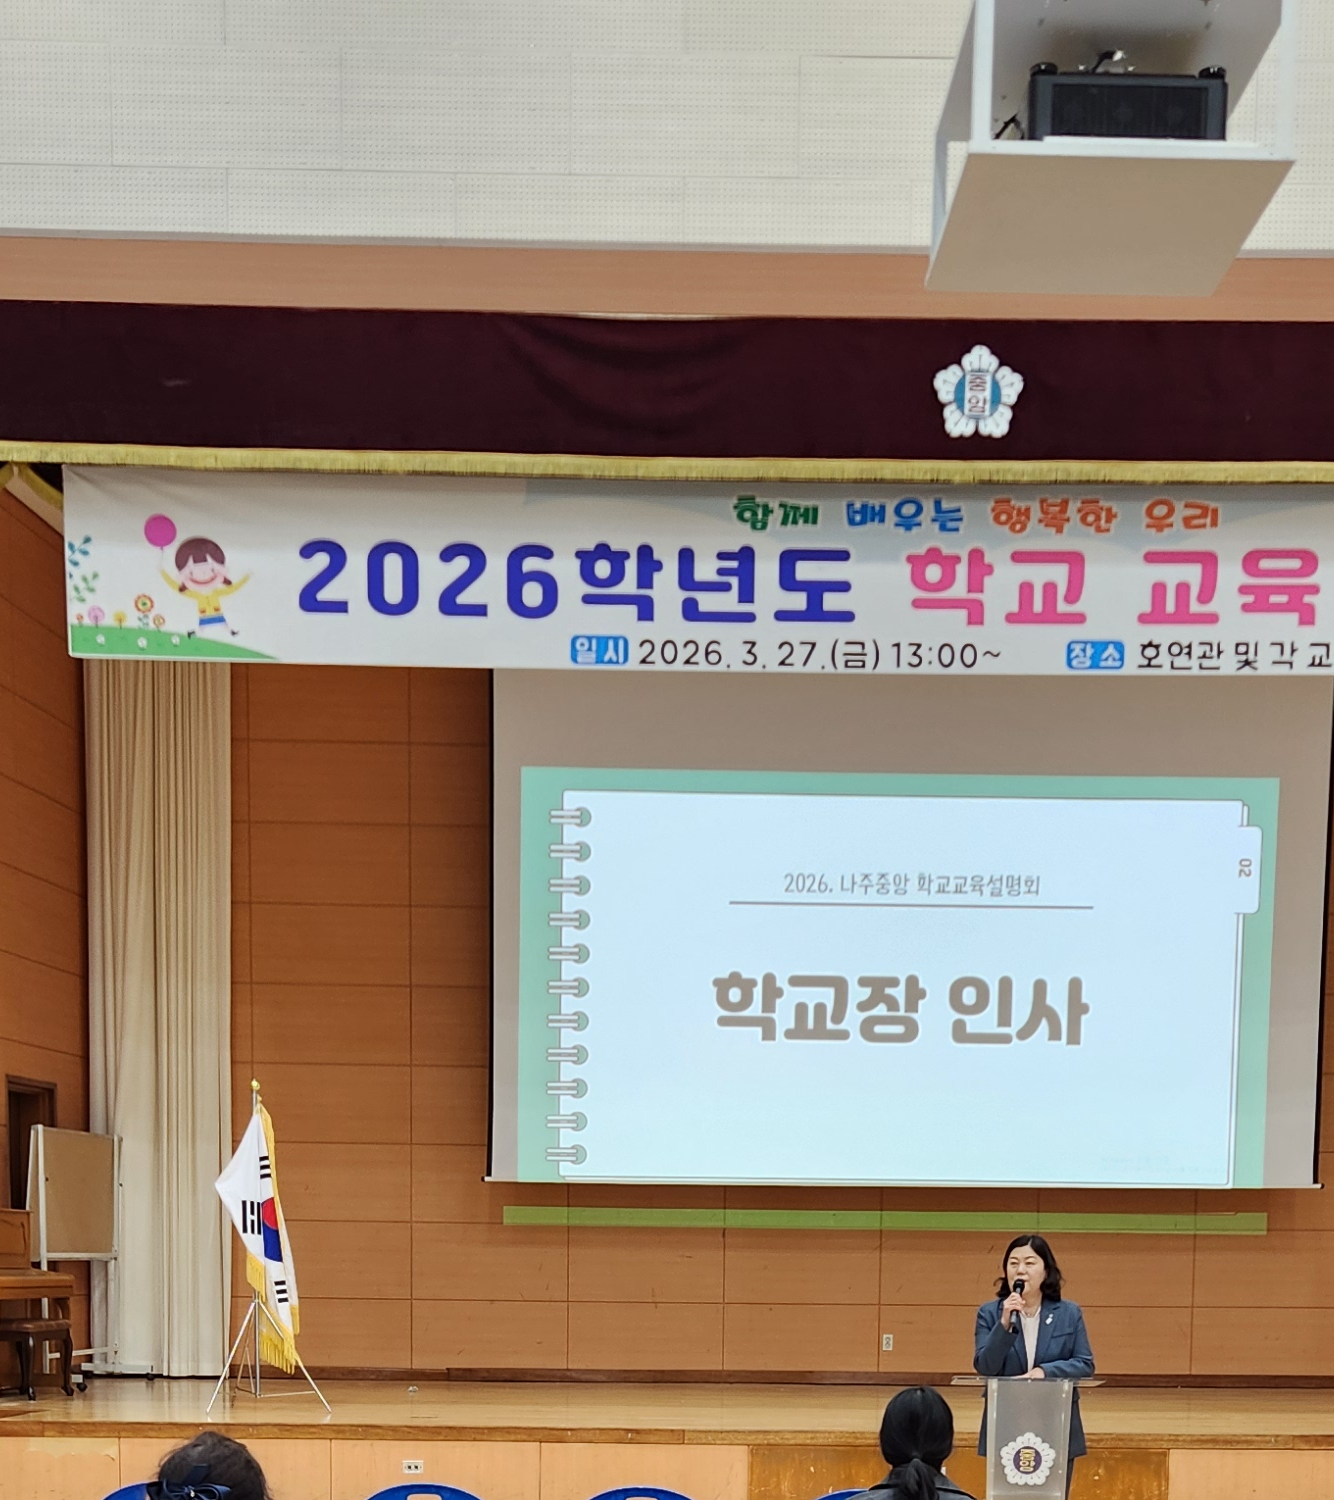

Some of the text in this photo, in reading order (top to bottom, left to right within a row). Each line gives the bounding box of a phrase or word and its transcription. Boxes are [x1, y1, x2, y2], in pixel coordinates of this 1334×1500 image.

[732, 494, 1220, 535] 함께 배우는 행복한 우리
[296, 538, 857, 624] 2026학년도
[905, 546, 1088, 627] 학교
[1136, 547, 1321, 628] 교육
[574, 638, 626, 663] 일시
[638, 639, 732, 669] 2026.
[740, 640, 767, 670] 3.
[890, 641, 1002, 669] 13:00~
[1069, 641, 1123, 669] 장소
[1136, 639, 1225, 671] 호연관
[1234, 640, 1260, 671] 및
[1269, 641, 1299, 670] 각
[1238, 858, 1253, 879] 02
[783, 872, 1041, 898] 2026. 나주중앙 학교교육설명회
[712, 970, 1091, 1046] 학교장 인사
